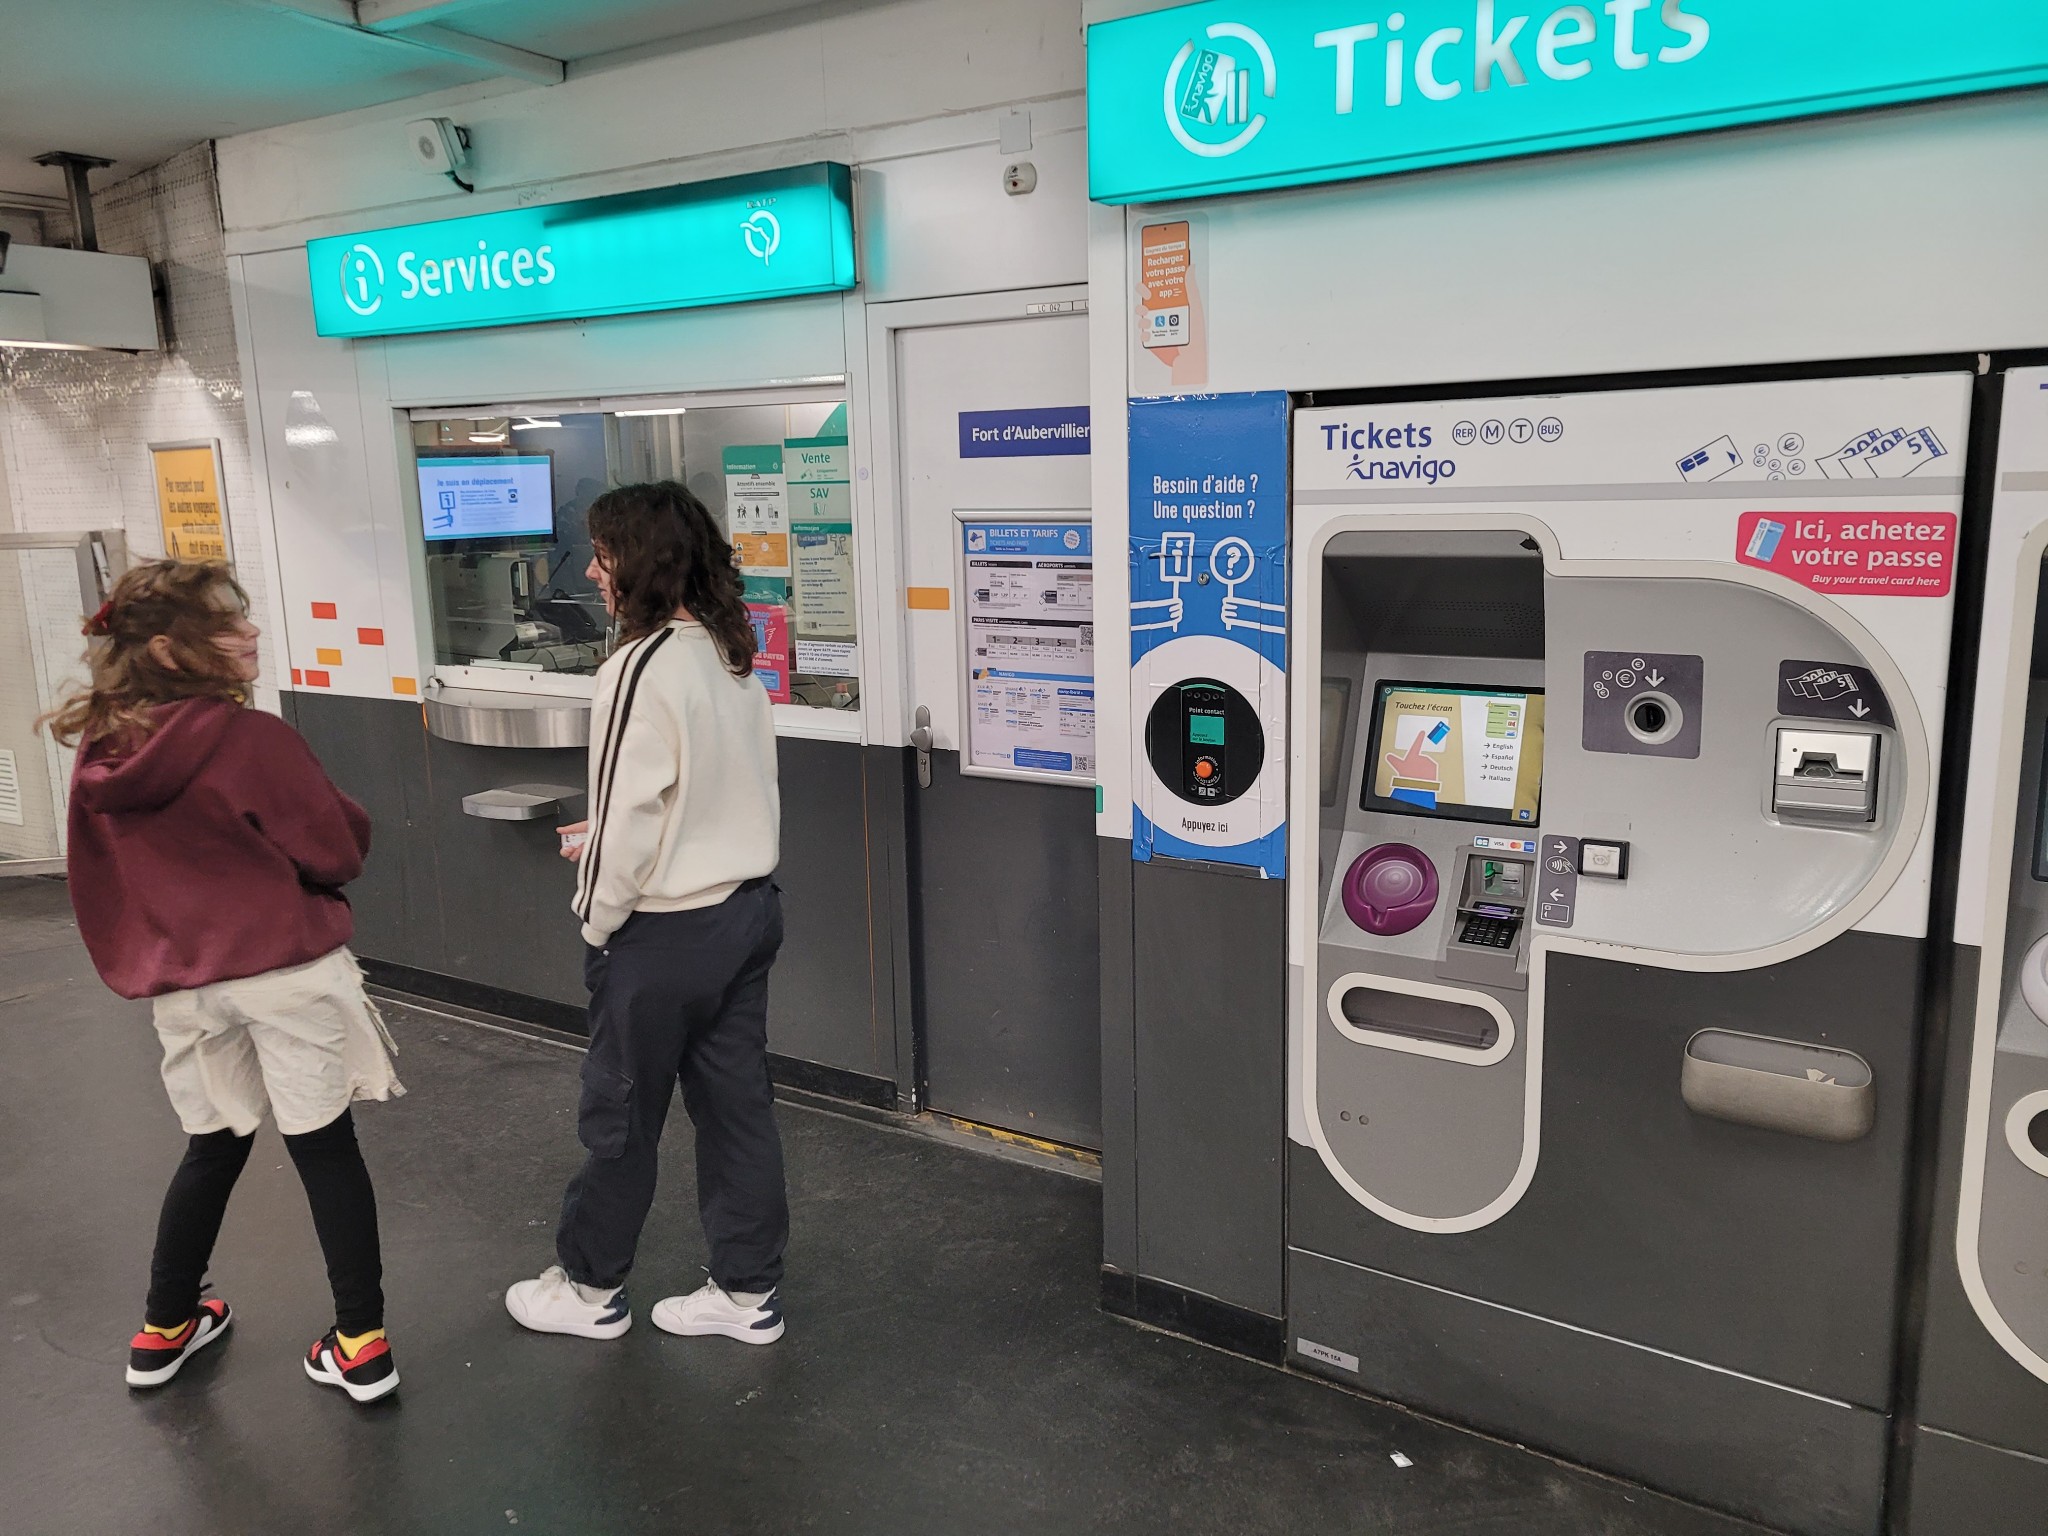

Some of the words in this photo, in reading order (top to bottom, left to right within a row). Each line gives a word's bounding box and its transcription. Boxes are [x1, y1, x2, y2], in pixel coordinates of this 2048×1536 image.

[1314, 0, 1711, 115] Tickets
[1147, 254, 1184, 267] Rechargez
[398, 240, 557, 300] Services
[1145, 267, 1165, 278] votre
[1165, 264, 1186, 277] passe
[1147, 279, 1164, 289] avec
[1164, 275, 1184, 287] votre
[1159, 288, 1173, 298] app
[972, 426, 1000, 442] Fort
[1320, 422, 1433, 451] Tickets
[1455, 428, 1474, 438] RER
[1485, 425, 1499, 439] M
[1515, 424, 1527, 438] T
[1540, 424, 1561, 435] BUS
[801, 453, 831, 464] Vente
[1368, 454, 1456, 485] navigo
[471, 476, 514, 487] déplacement
[1153, 475, 1198, 495] Besoin
[1202, 474, 1245, 494] d'aide
[1250, 473, 1259, 493] ?
[810, 487, 830, 499] SAV
[1153, 500, 1178, 519] Une
[1182, 500, 1243, 523] question
[1247, 499, 1256, 519] ?
[989, 528, 1019, 538] BILLETS
[1020, 528, 1030, 538] ET
[1031, 529, 1059, 538] TARIFS
[1795, 520, 1833, 543] Ici,
[1840, 519, 1946, 541] achetez
[1792, 546, 1858, 566] votre
[1867, 550, 1943, 571] passe
[1812, 574, 1834, 587] Buy
[1835, 577, 1857, 587] your
[1859, 575, 1888, 585] travel
[1891, 575, 1913, 586] card
[1917, 575, 1940, 586] here
[992, 635, 997, 644] 1
[1012, 636, 1018, 644] 2
[1035, 637, 1040, 646] 3
[1056, 639, 1062, 647] 5
[1188, 707, 1204, 715] Point
[1204, 708, 1225, 716] contact
[1395, 701, 1426, 711] Touchez
[1426, 703, 1453, 712] l'écran
[1492, 743, 1514, 751] English
[1491, 753, 1514, 761] Español
[1489, 764, 1514, 772] Deutsch
[1181, 816, 1215, 833] Appuyez
[1217, 822, 1229, 833] ici
